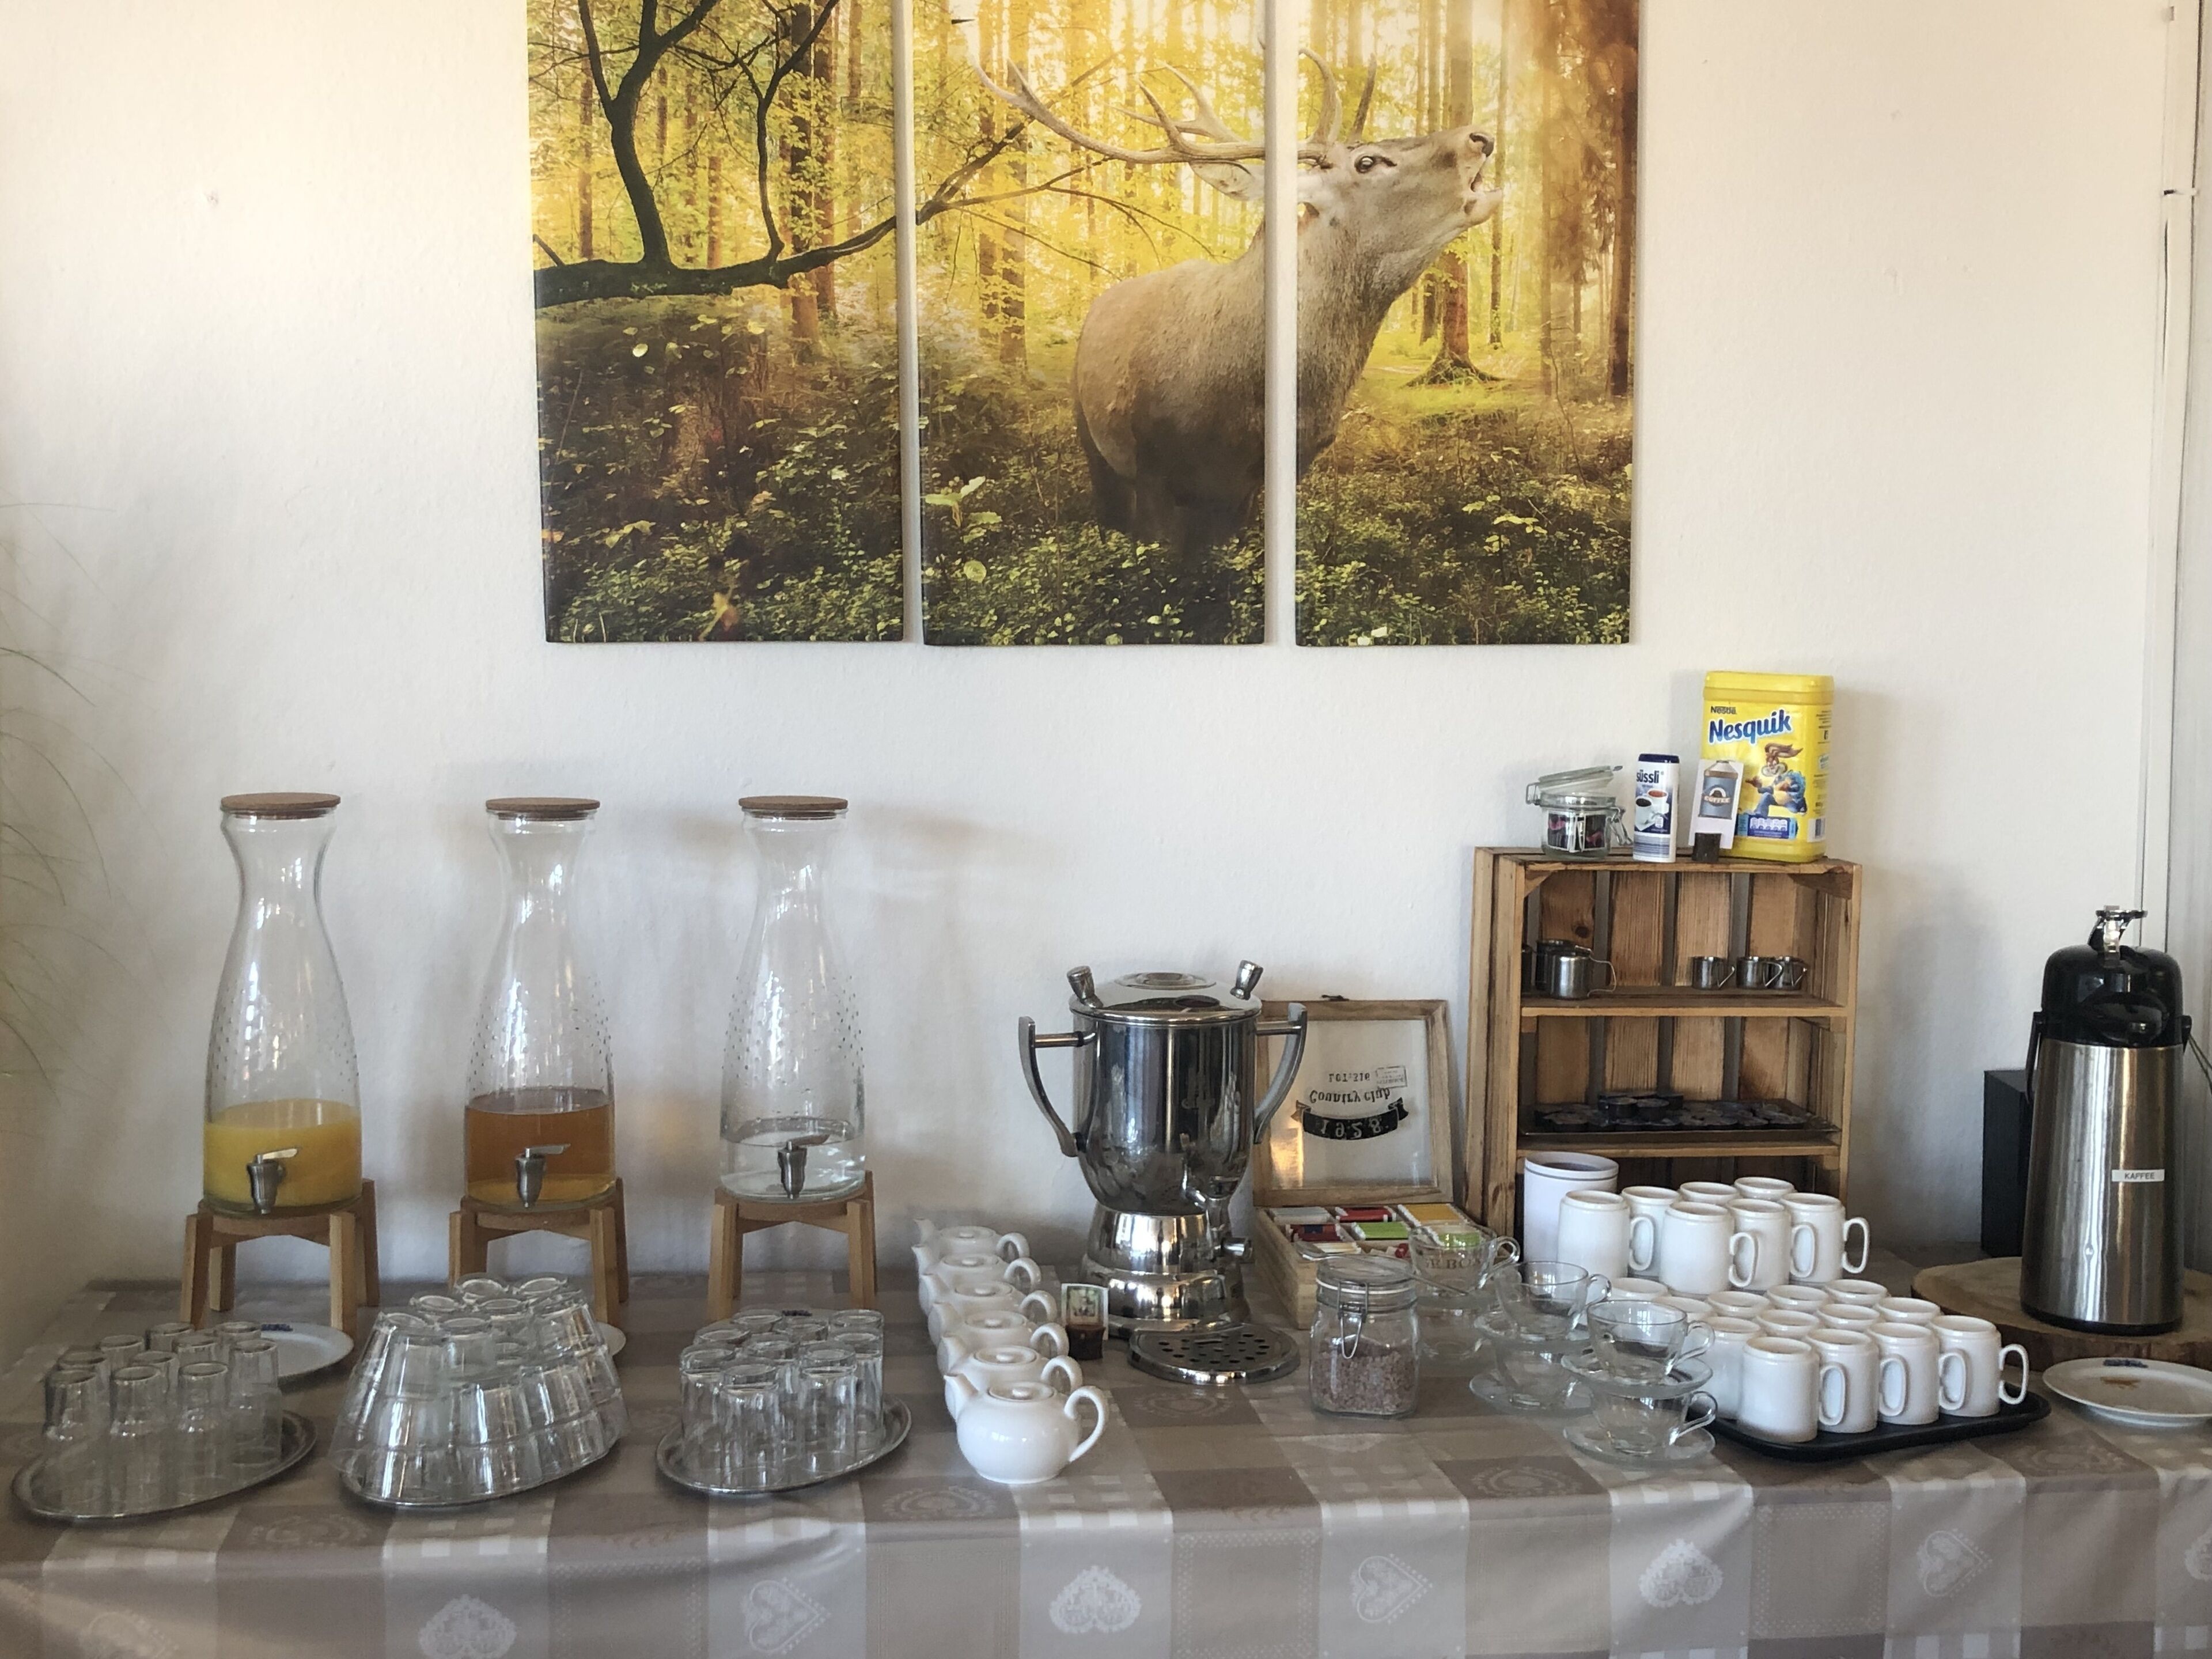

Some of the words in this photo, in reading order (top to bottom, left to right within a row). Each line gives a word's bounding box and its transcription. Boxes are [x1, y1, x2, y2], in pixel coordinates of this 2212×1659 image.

[1709, 709, 1792, 744] Nesquik
[1636, 770, 1660, 783] süssli
[1704, 796, 1731, 804] COFFEE
